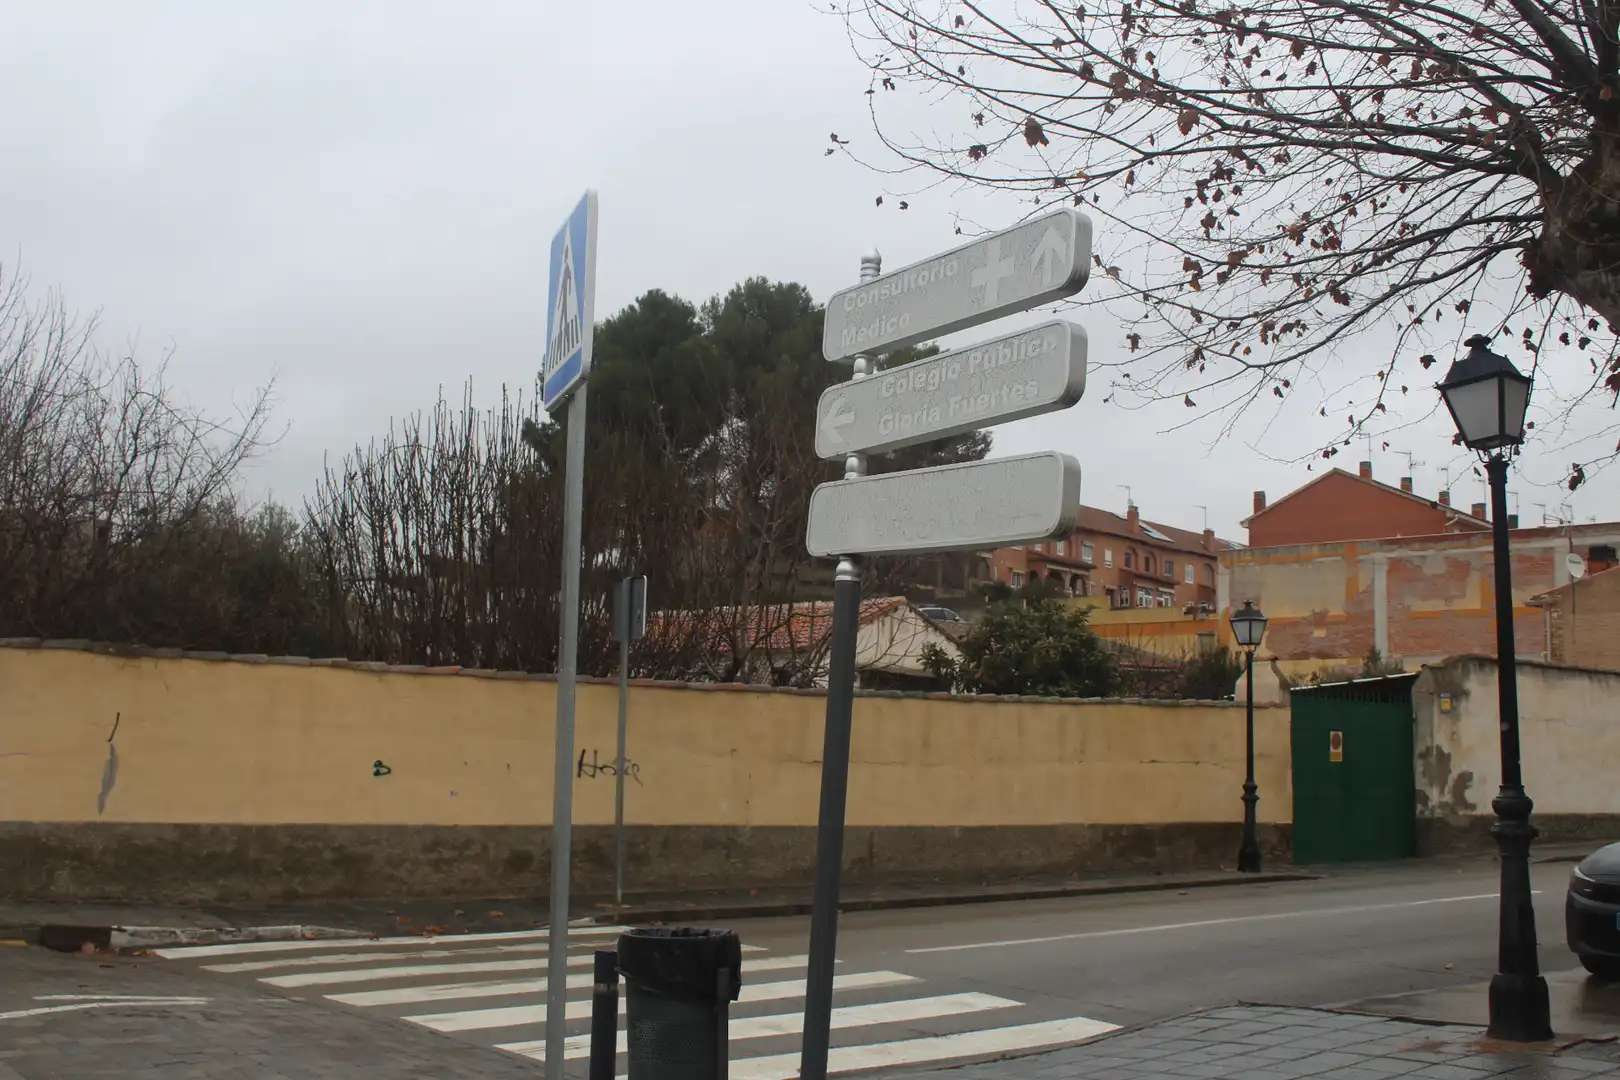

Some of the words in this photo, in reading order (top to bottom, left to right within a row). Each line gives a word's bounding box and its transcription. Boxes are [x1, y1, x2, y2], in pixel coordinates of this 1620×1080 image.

[880, 361, 961, 398] Colegio
[879, 404, 940, 436] Gloria
[949, 380, 1039, 418] Fuertes
